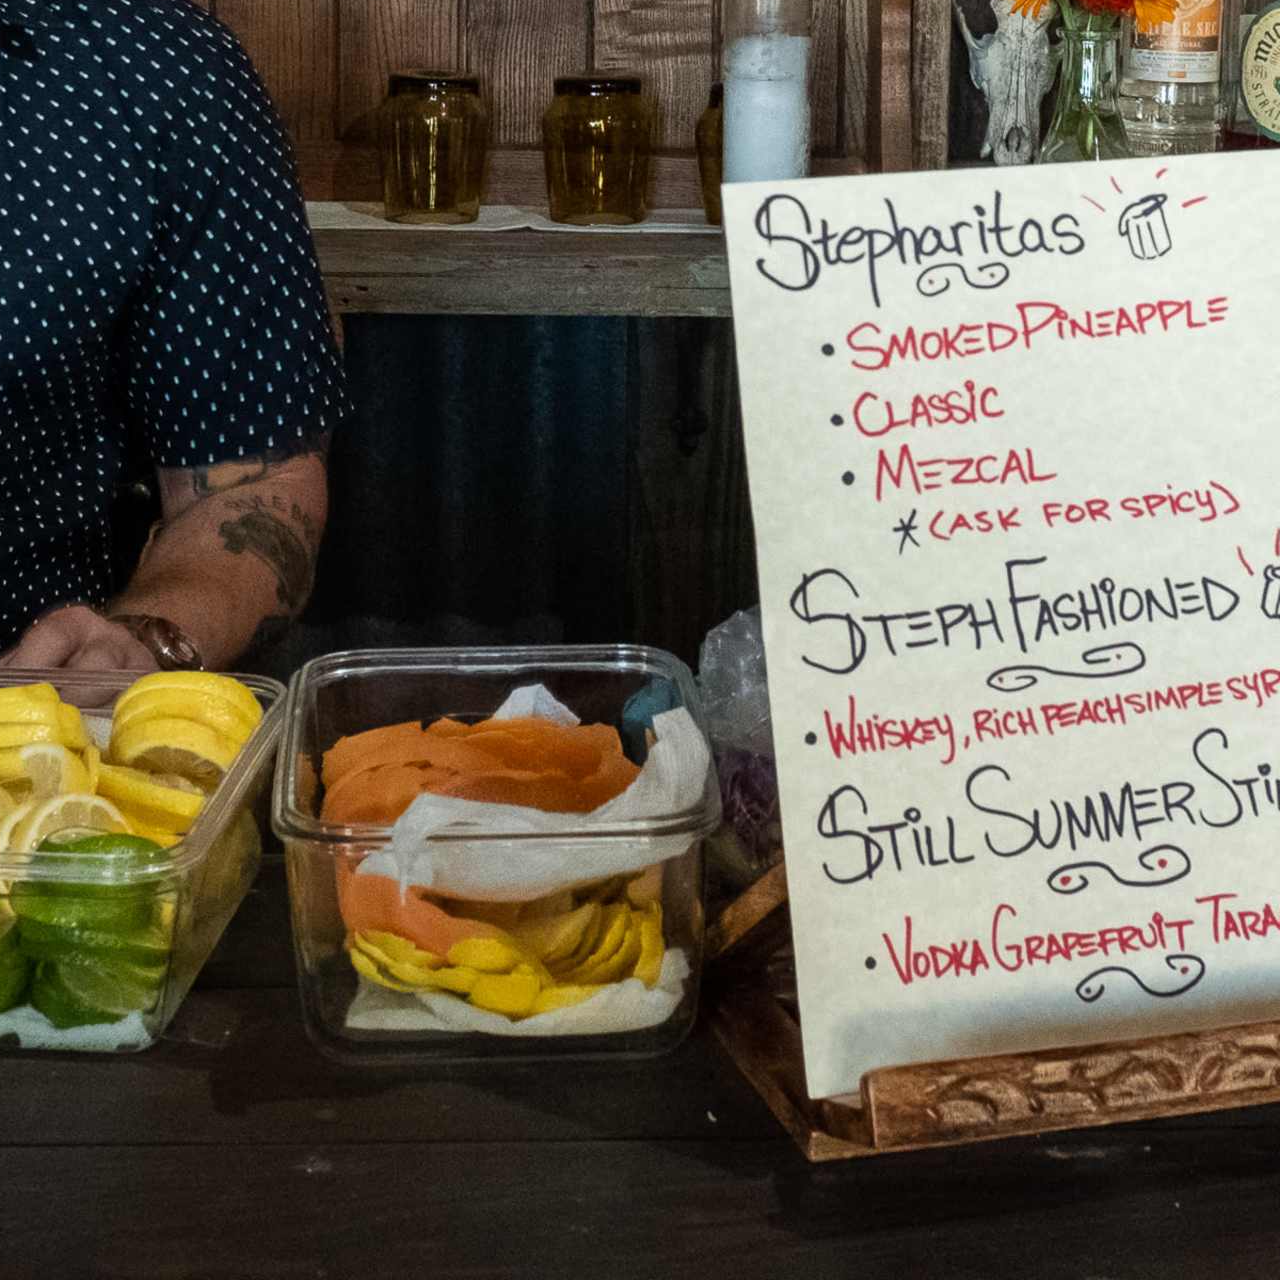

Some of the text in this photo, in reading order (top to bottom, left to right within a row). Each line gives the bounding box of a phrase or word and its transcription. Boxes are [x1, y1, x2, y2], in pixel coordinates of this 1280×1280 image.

[756, 190, 1085, 307] Stepharitas
[847, 317, 1018, 371] SMOKED
[853, 379, 1004, 438] CLASSIC
[873, 444, 1057, 502] MEZCAL
[1043, 497, 1109, 529] FOR
[790, 556, 1240, 674] STEPH FASHIONED
[974, 708, 1038, 742] RICH
[1041, 693, 1127, 735] PEACH
[1124, 681, 1223, 714] SIMPLE
[818, 784, 975, 885] STILL
[965, 764, 1195, 858] SUMMER
[882, 915, 990, 985] VODKA
[991, 903, 1195, 972] GRAPEFRUIT
